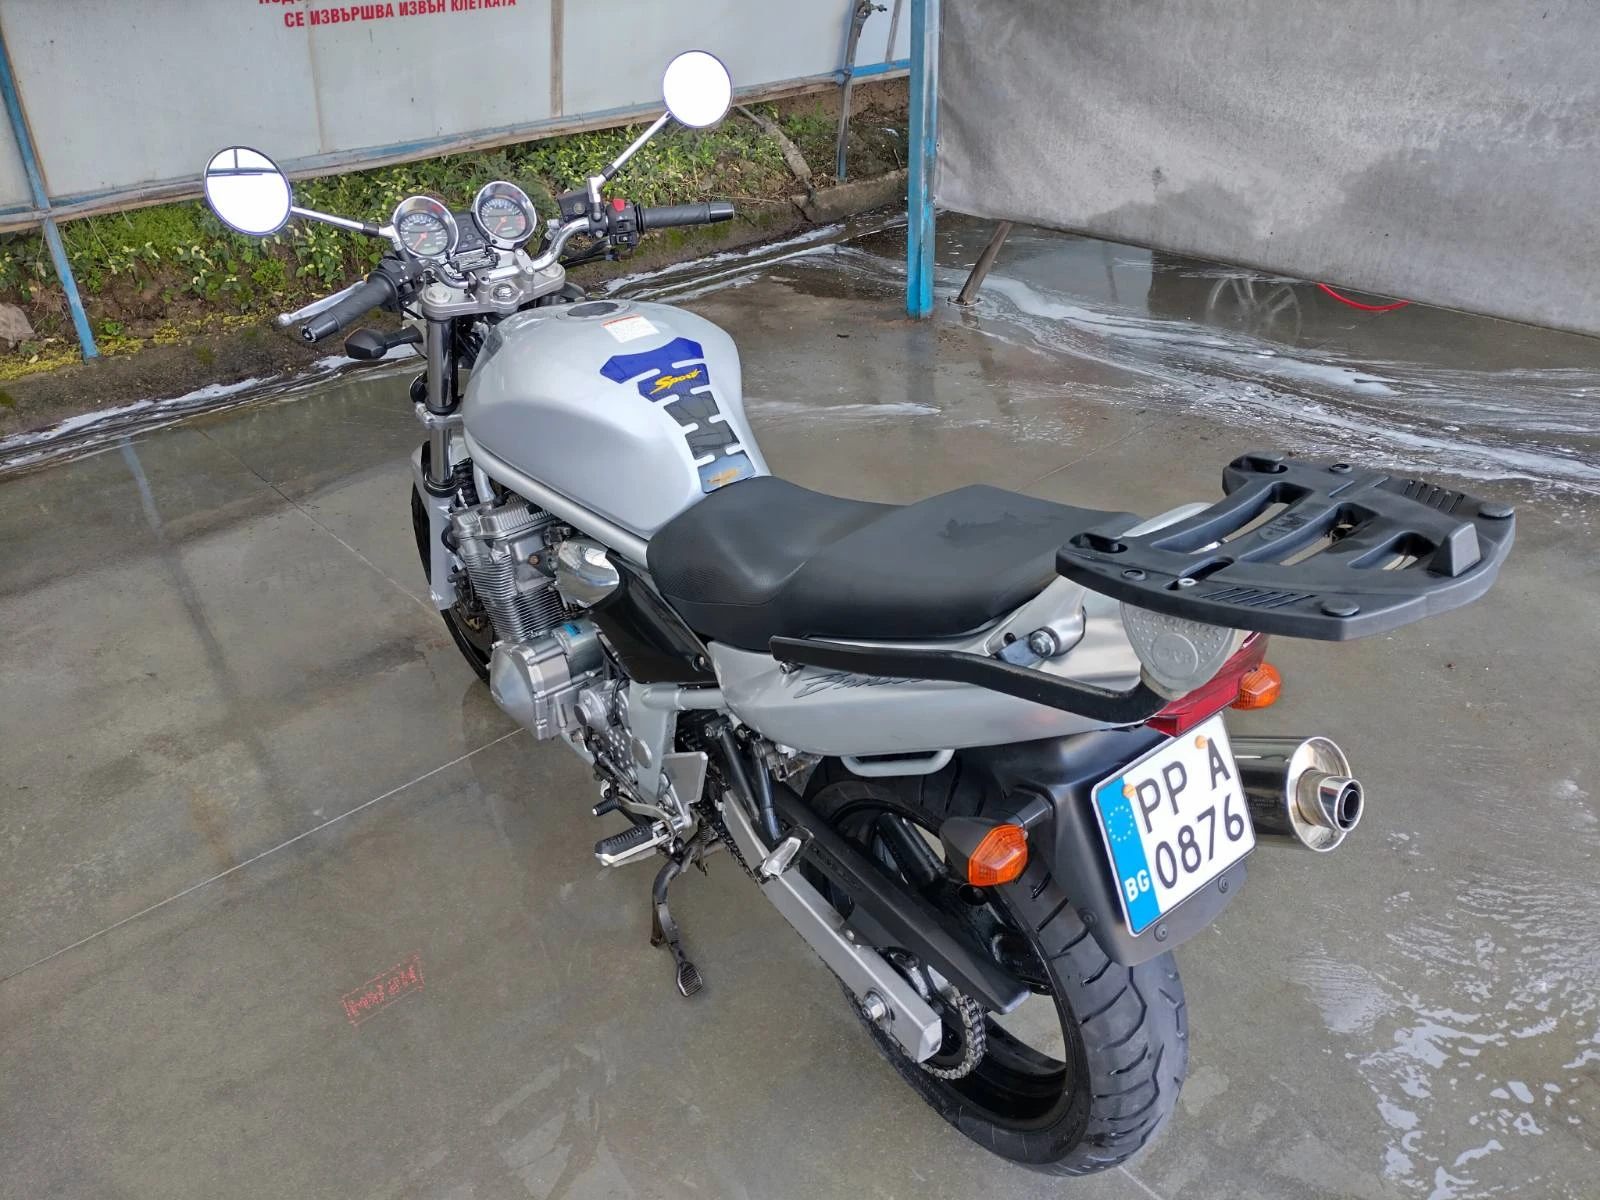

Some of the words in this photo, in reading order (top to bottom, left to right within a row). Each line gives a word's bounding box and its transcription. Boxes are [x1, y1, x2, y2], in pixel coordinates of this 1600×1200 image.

[284, 11, 304, 27] СЕ
[310, 3, 394, 26] ИЗВЪРШВА
[399, 0, 446, 16] ИЗВЪН
[1135, 761, 1188, 834] PP
[1207, 737, 1231, 791] A
[1155, 794, 1245, 889] 0876
[1124, 869, 1150, 901] BG
